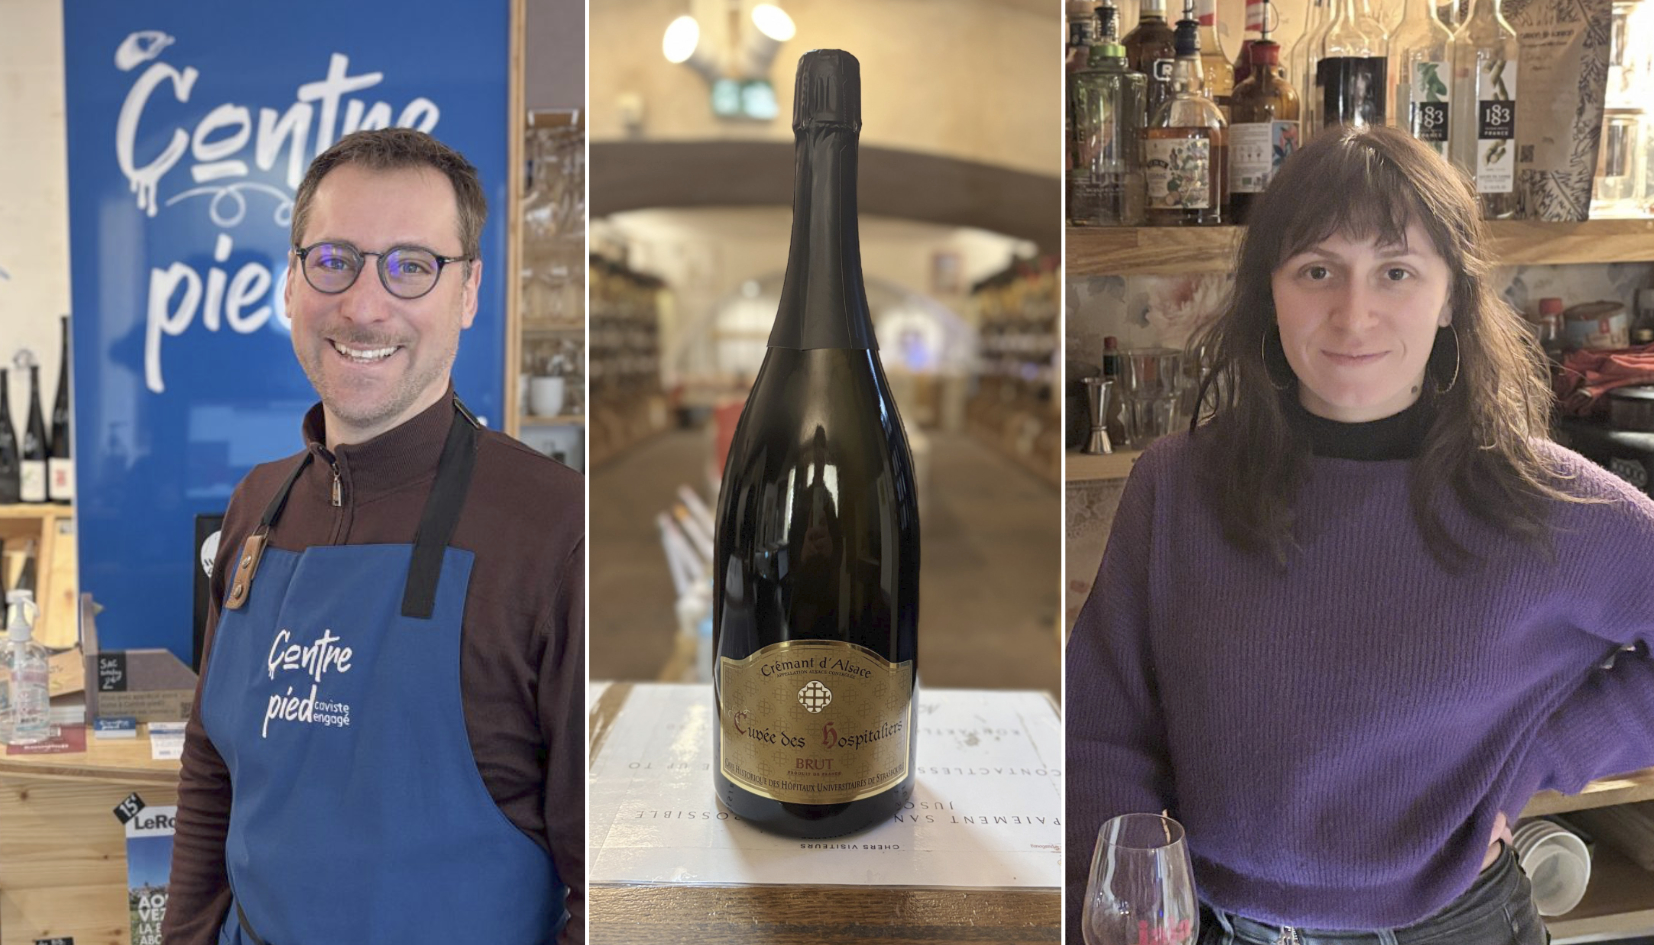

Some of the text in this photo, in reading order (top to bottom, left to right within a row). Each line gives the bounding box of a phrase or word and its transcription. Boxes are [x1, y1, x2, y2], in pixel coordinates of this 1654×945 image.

[268, 629, 353, 682] Contre
[761, 657, 872, 679] Crémant d'Alsace
[262, 684, 318, 738] pied
[314, 700, 350, 714] caviste
[313, 713, 350, 727] engagé
[734, 712, 903, 750] Cuvée des Hospitaliers
[796, 758, 834, 770] BRUT
[918, 767, 1062, 776] CONTACTLESS
[134, 814, 176, 830] LeRo
[893, 815, 1062, 825] PAIEMENT SAN
[139, 923, 152, 934] LA
